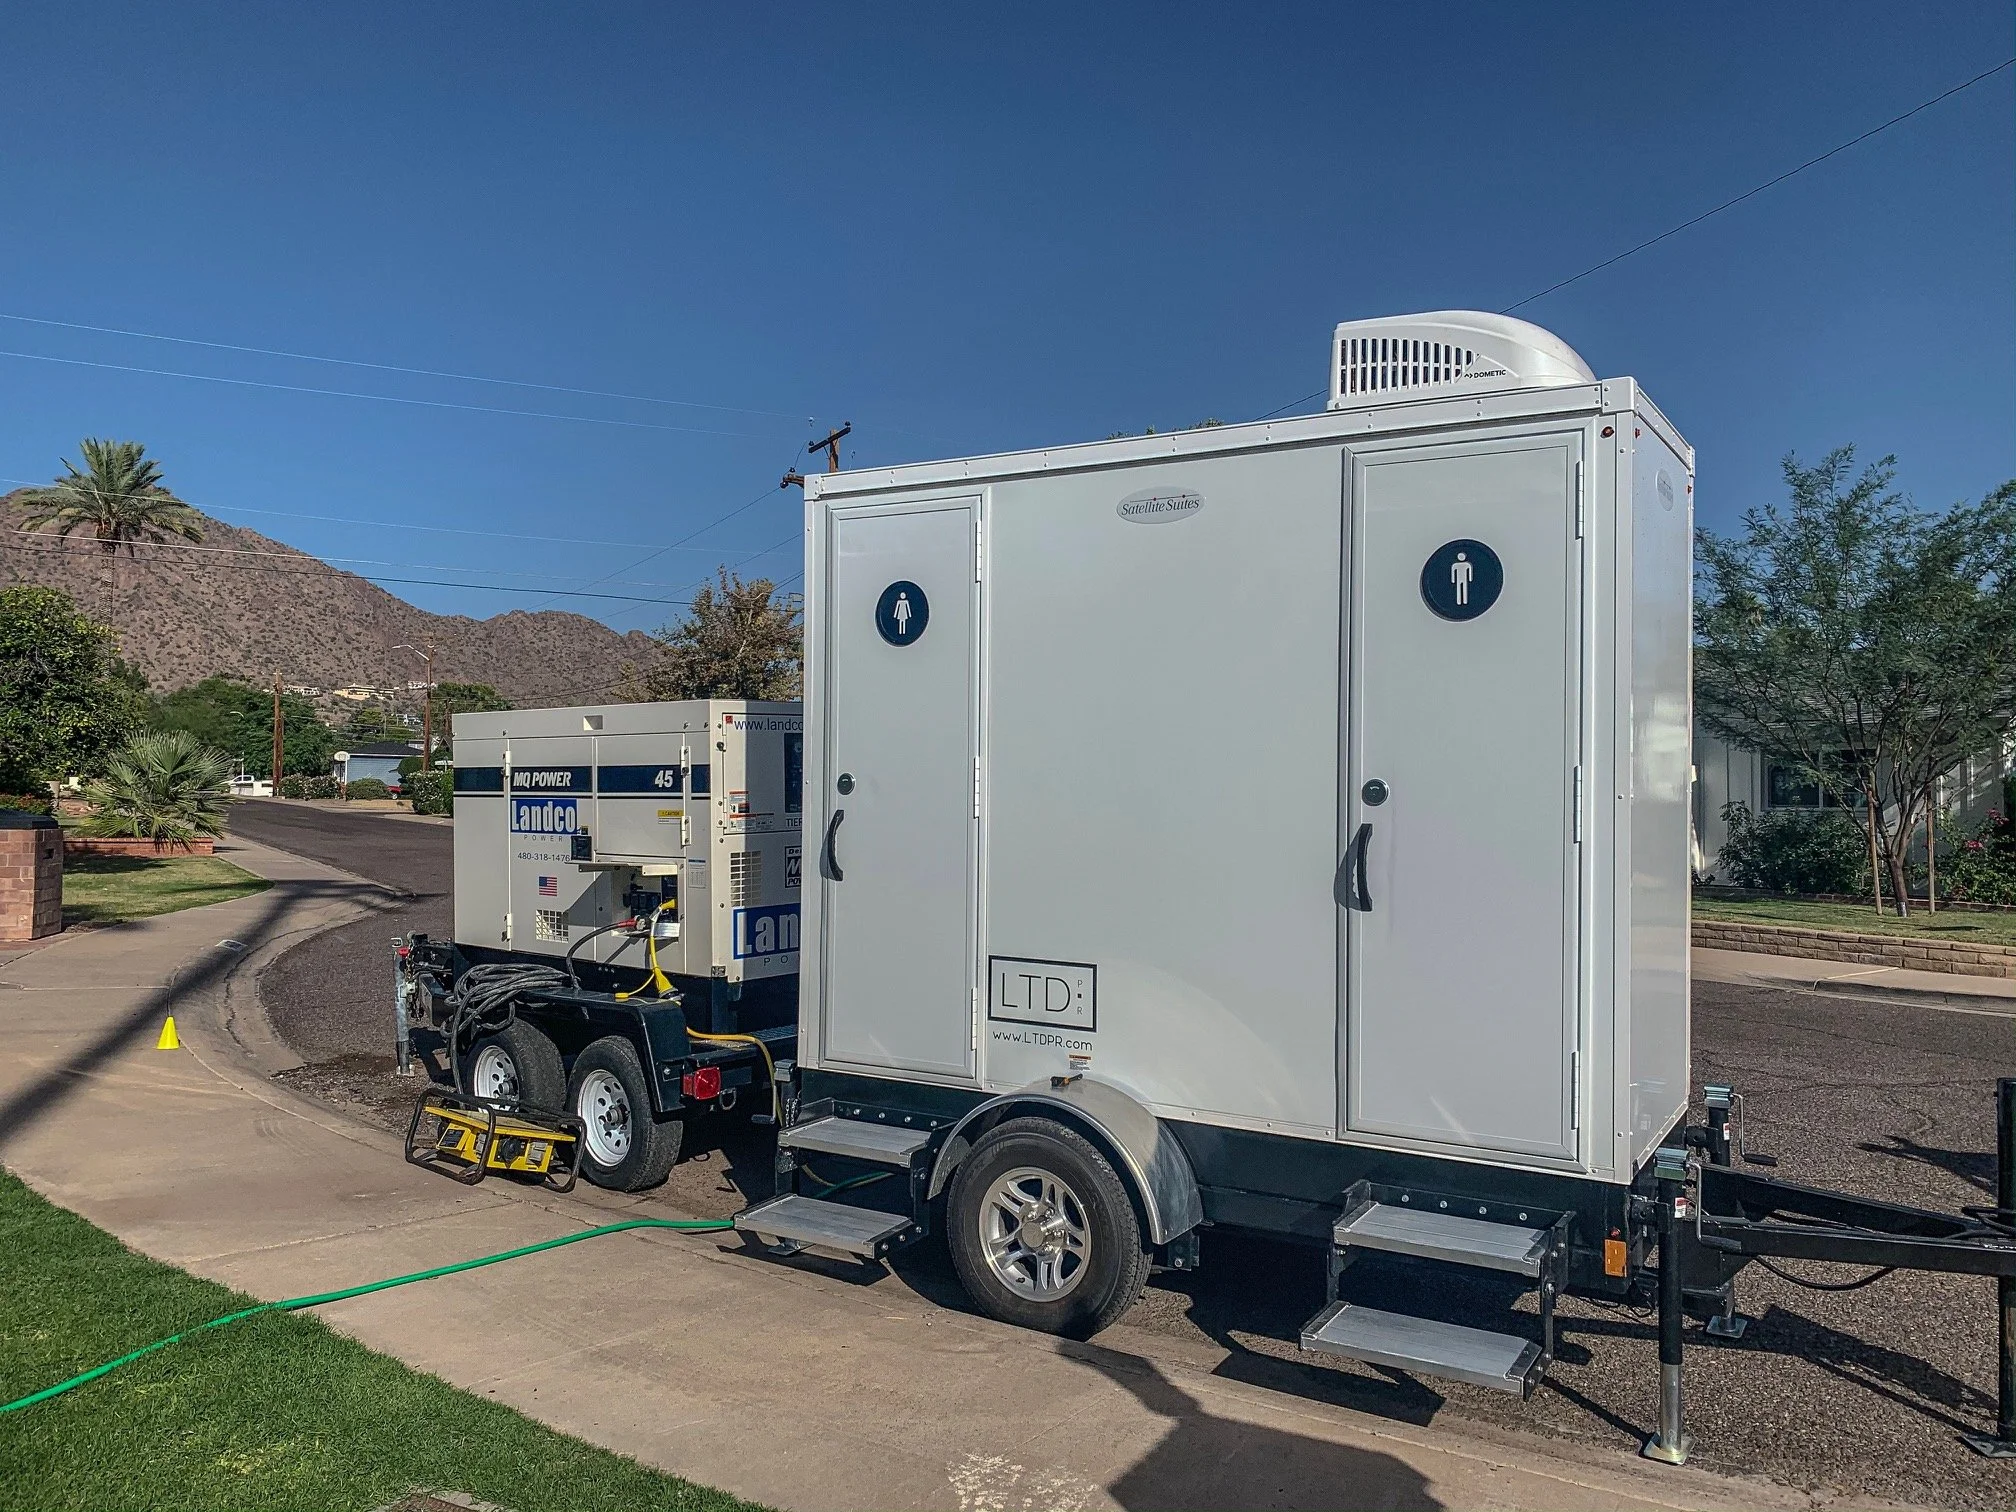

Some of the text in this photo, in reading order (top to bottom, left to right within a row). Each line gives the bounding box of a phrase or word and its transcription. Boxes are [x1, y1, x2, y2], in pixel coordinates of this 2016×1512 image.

[1474, 369, 1507, 379] DOMETIC
[1121, 499, 1200, 515] Satellite Suites
[513, 771, 572, 789] MQ POWER
[654, 769, 674, 788] 45
[511, 800, 576, 833] Landco
[524, 834, 563, 842] POWER
[517, 851, 571, 862] 480-318-1476
[1001, 972, 1071, 1013] LTD
[992, 1031, 1093, 1051] www.LTDPR.com
